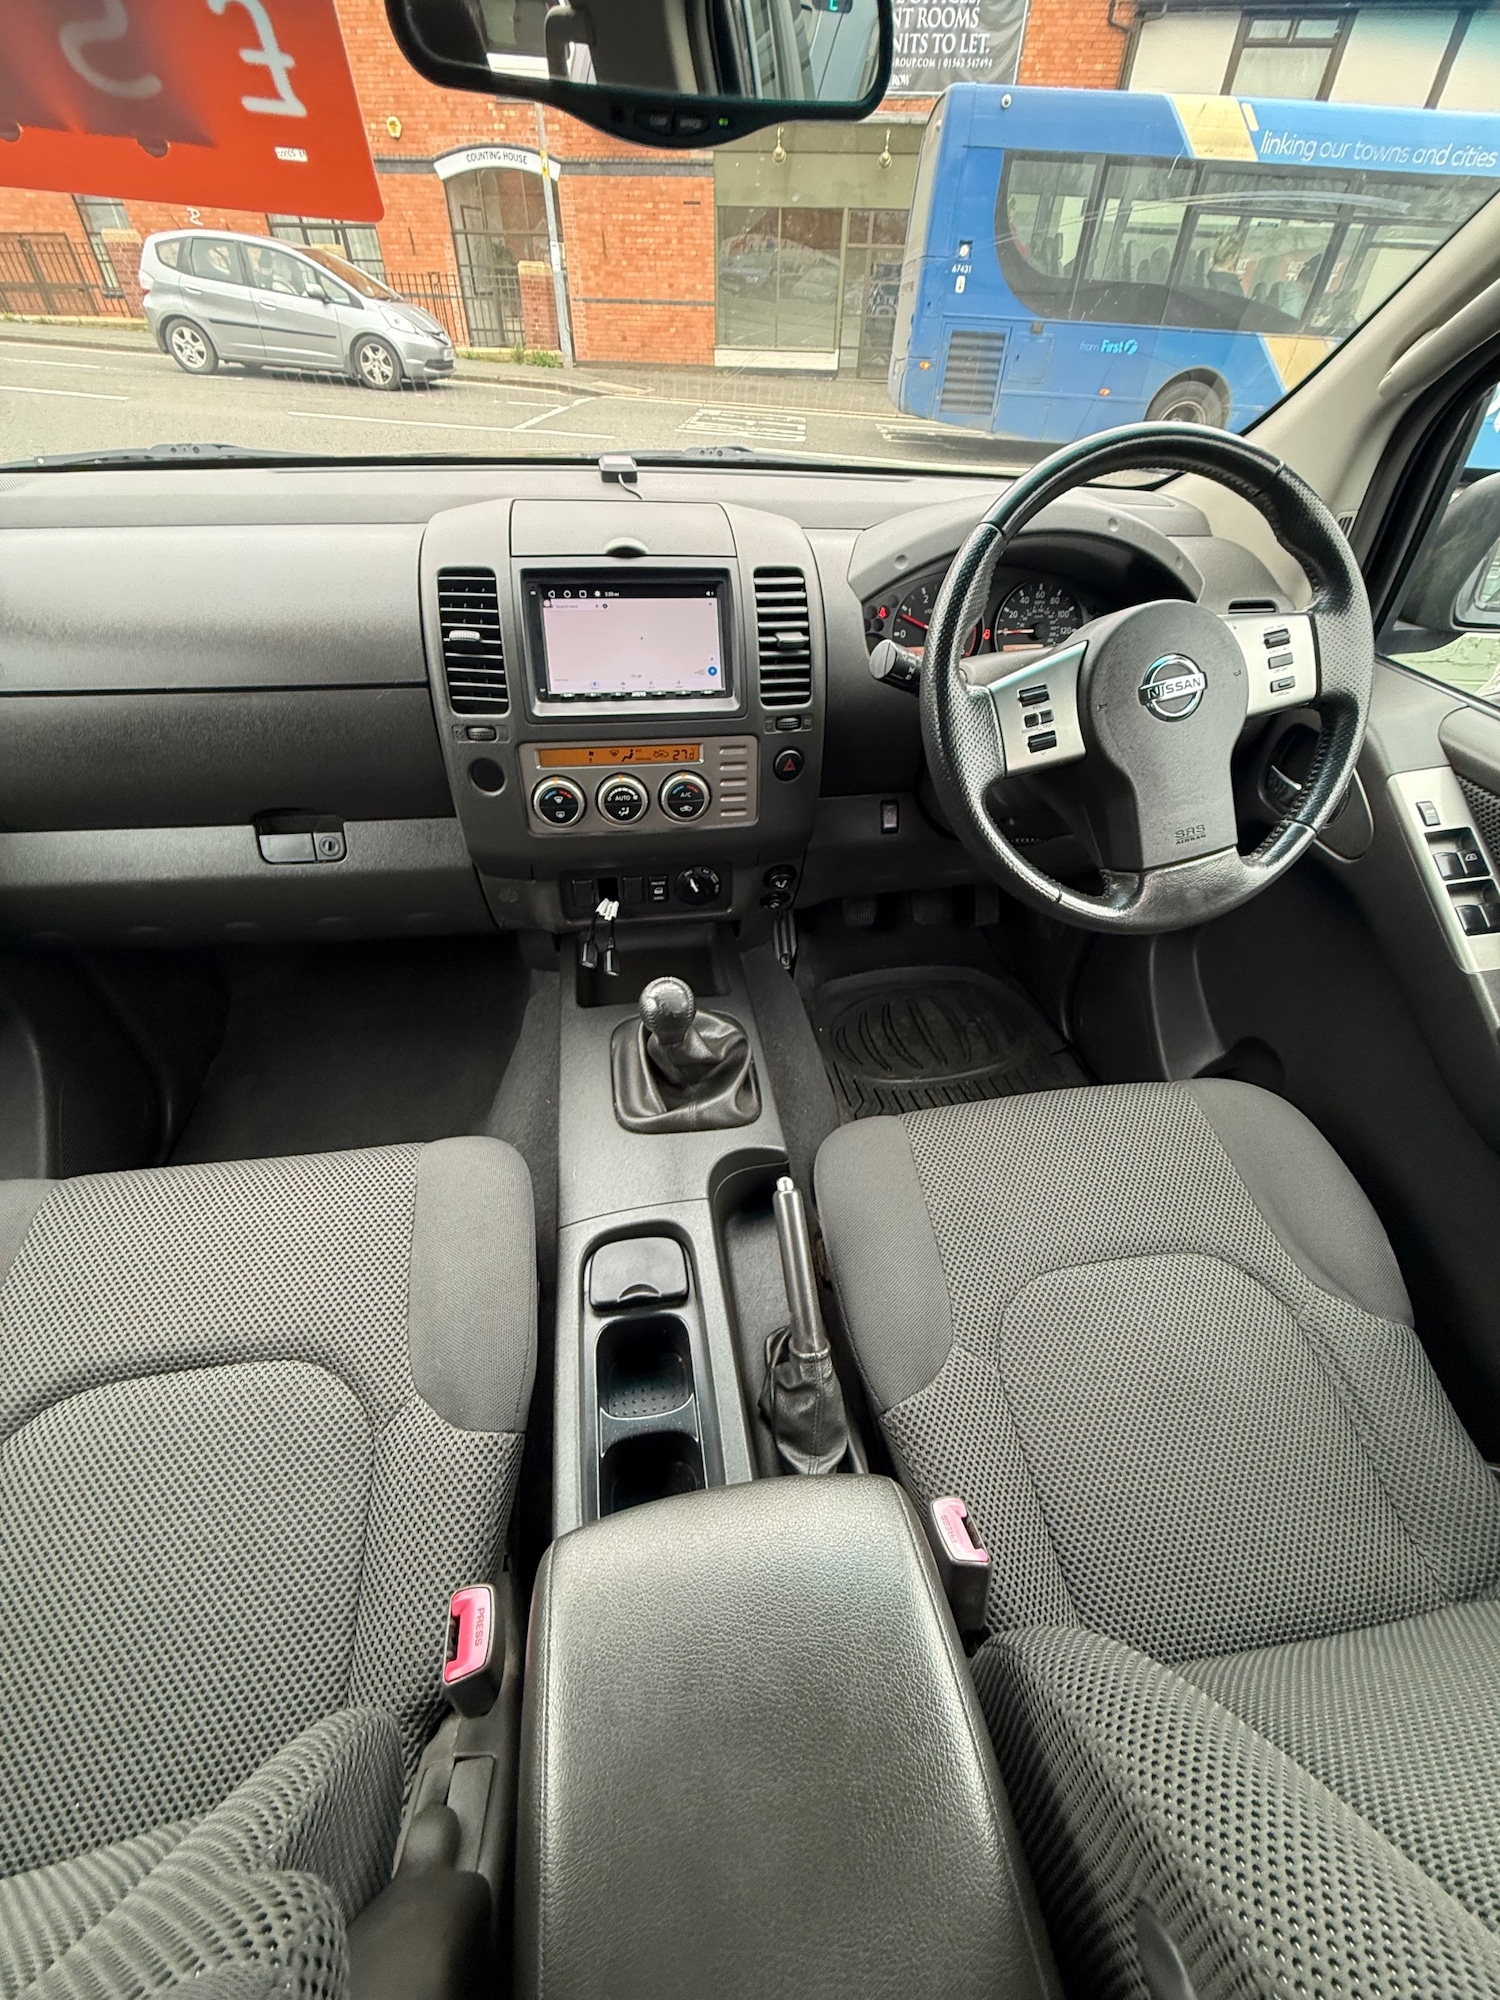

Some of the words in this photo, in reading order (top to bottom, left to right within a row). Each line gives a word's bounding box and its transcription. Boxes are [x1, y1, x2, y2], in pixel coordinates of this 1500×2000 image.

[917, 7, 980, 28] ROOMS
[932, 33, 956, 54] TO
[960, 33, 990, 54] LET.
[892, 57, 935, 68] ROUP.COM
[1260, 130, 1318, 161] linking
[1319, 141, 1352, 158] our
[1353, 140, 1410, 164] towns
[1412, 143, 1453, 166] and
[1451, 145, 1498, 168] cities
[466, 151, 501, 163] COUNTING
[503, 151, 528, 165] HOUSE
[951, 264, 972, 274] 67431
[1080, 340, 1099, 352] from
[1101, 339, 1123, 353] First
[923, 595, 929, 604] 2
[1019, 596, 1030, 605] 40
[1035, 590, 1046, 599] 60
[1050, 596, 1060, 605] 80
[1008, 610, 1019, 619] 20
[1057, 610, 1070, 618] 100
[1060, 626, 1072, 635] 120
[1146, 677, 1202, 700] NISSAN
[1174, 824, 1206, 839] SRS
[941, 1514, 958, 1544] PRESS
[474, 1607, 486, 1647] PRESS
